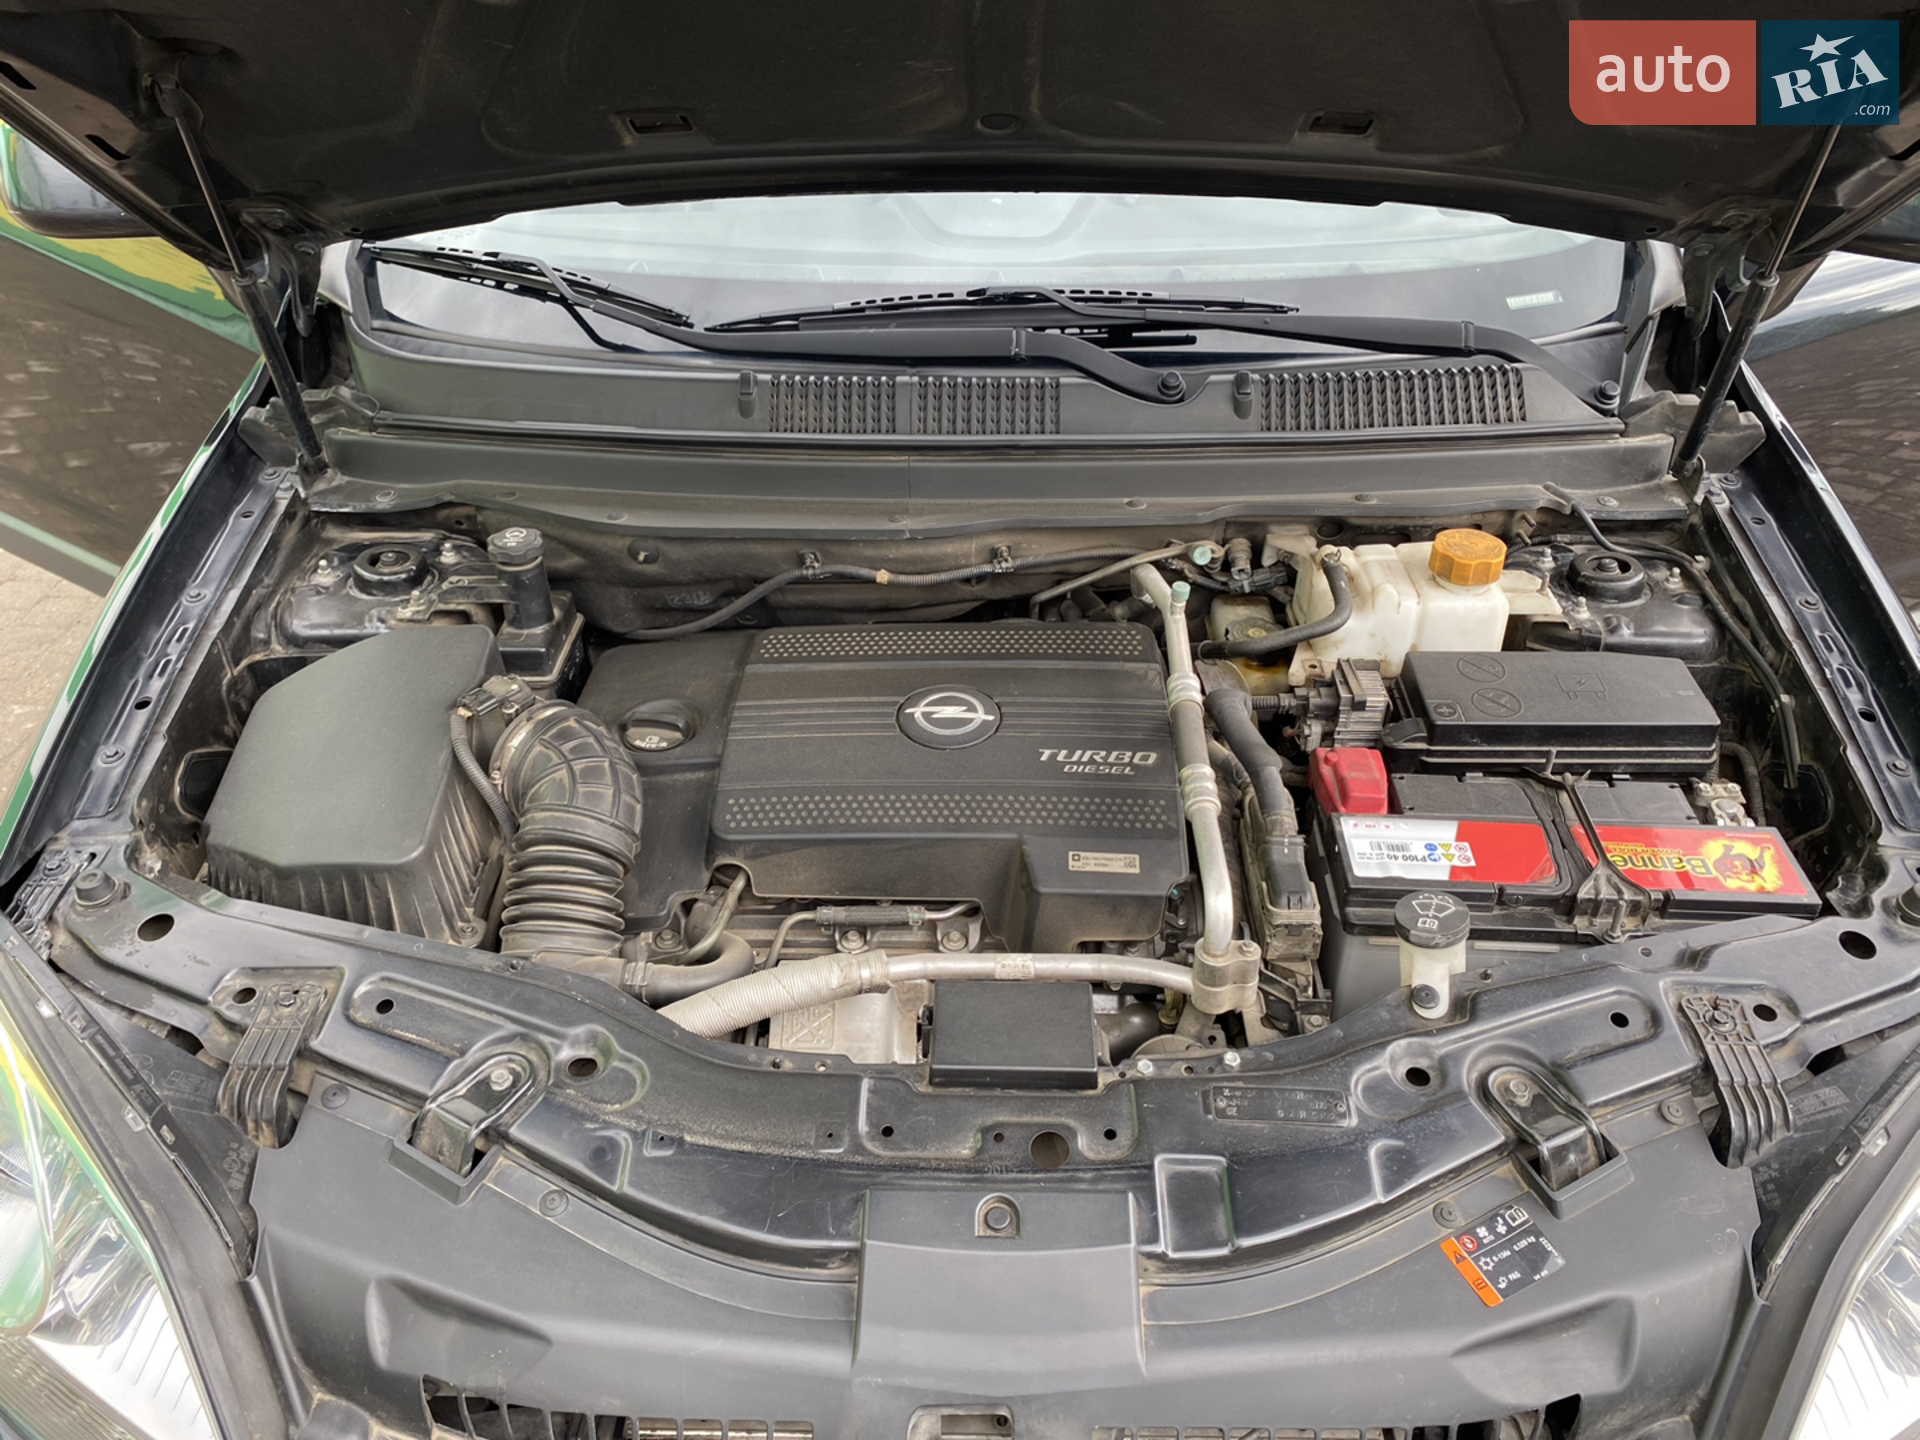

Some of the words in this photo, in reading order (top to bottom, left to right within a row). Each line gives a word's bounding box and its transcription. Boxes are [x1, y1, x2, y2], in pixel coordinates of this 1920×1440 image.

[1038, 748, 1158, 765] TURBO
[1063, 764, 1136, 776] DIESEL
[1608, 853, 1714, 877] Banne
